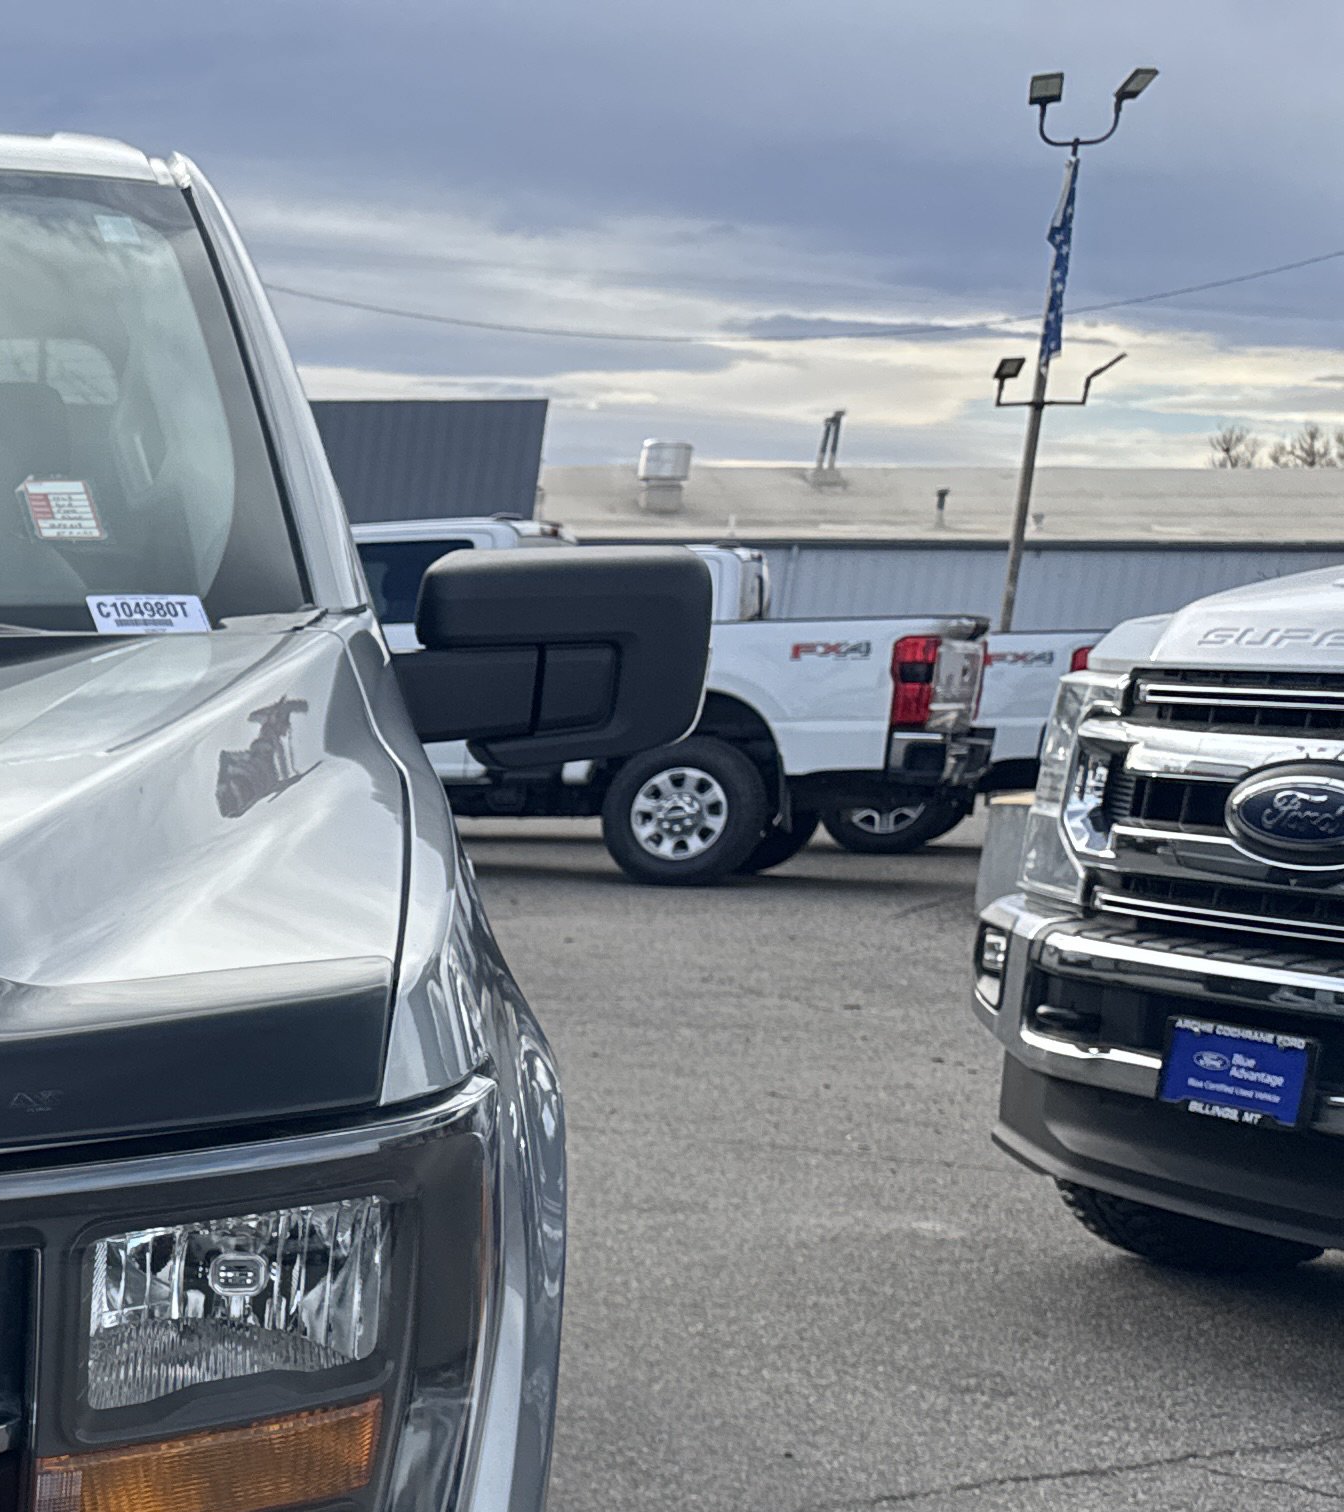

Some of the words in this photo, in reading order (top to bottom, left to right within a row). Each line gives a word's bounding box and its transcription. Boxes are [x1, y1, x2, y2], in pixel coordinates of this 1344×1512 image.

[96, 601, 189, 618] C104980T
[790, 640, 872, 660] FX4
[1242, 1111, 1262, 1126] MT
